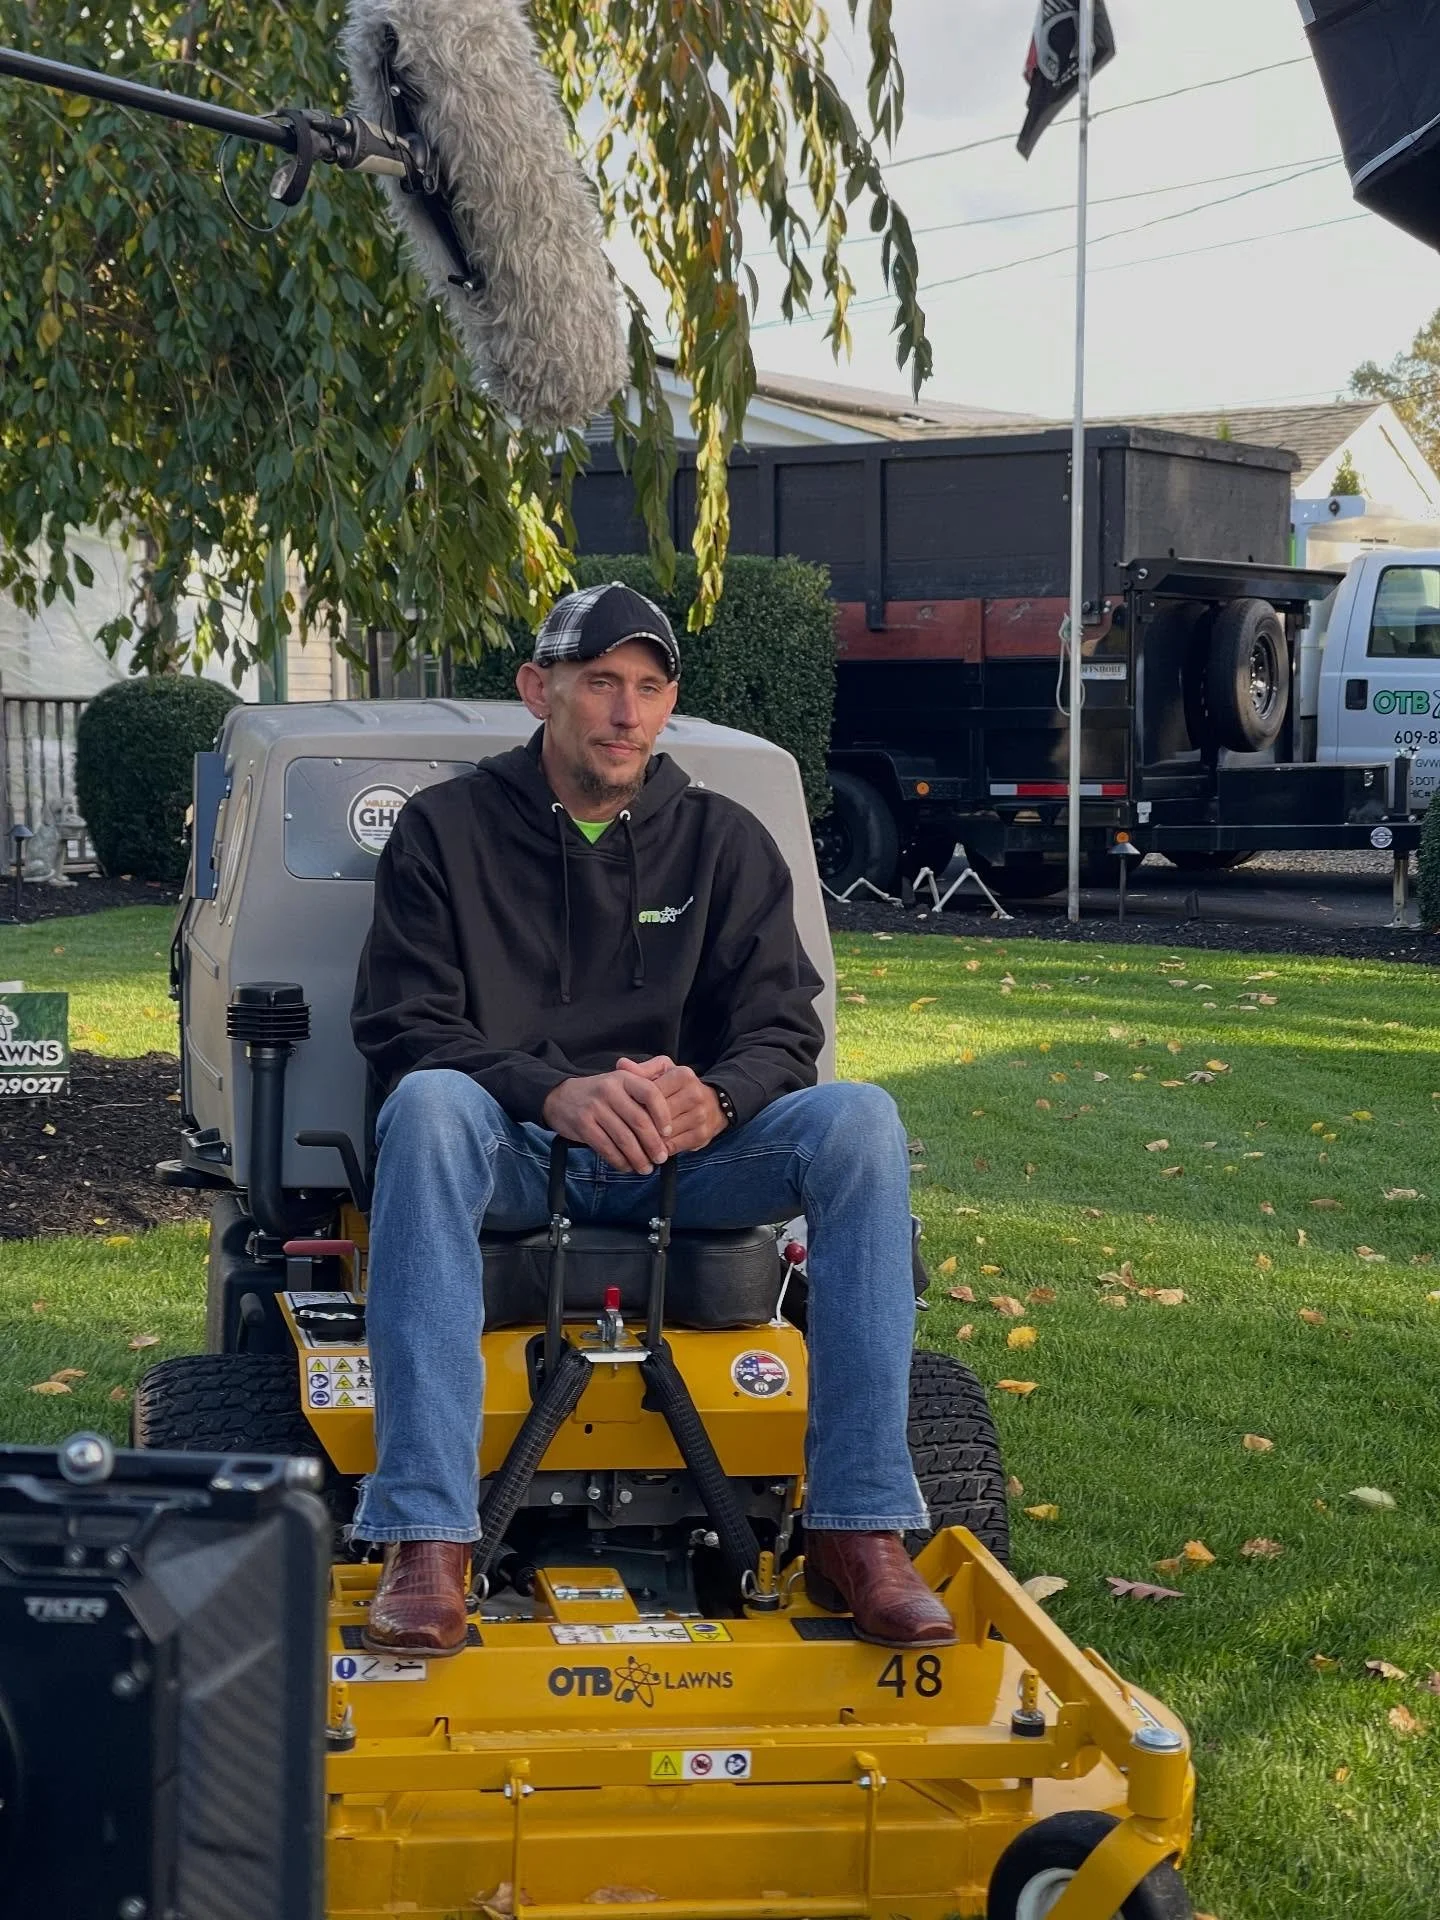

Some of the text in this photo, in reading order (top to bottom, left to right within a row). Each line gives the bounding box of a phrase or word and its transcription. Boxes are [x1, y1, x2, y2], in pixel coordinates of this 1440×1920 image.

[1373, 690, 1430, 715] OTB
[1394, 730, 1440, 745] 609-8
[548, 1666, 734, 1697] OTB LAWNS
[877, 1654, 943, 1698] 48
